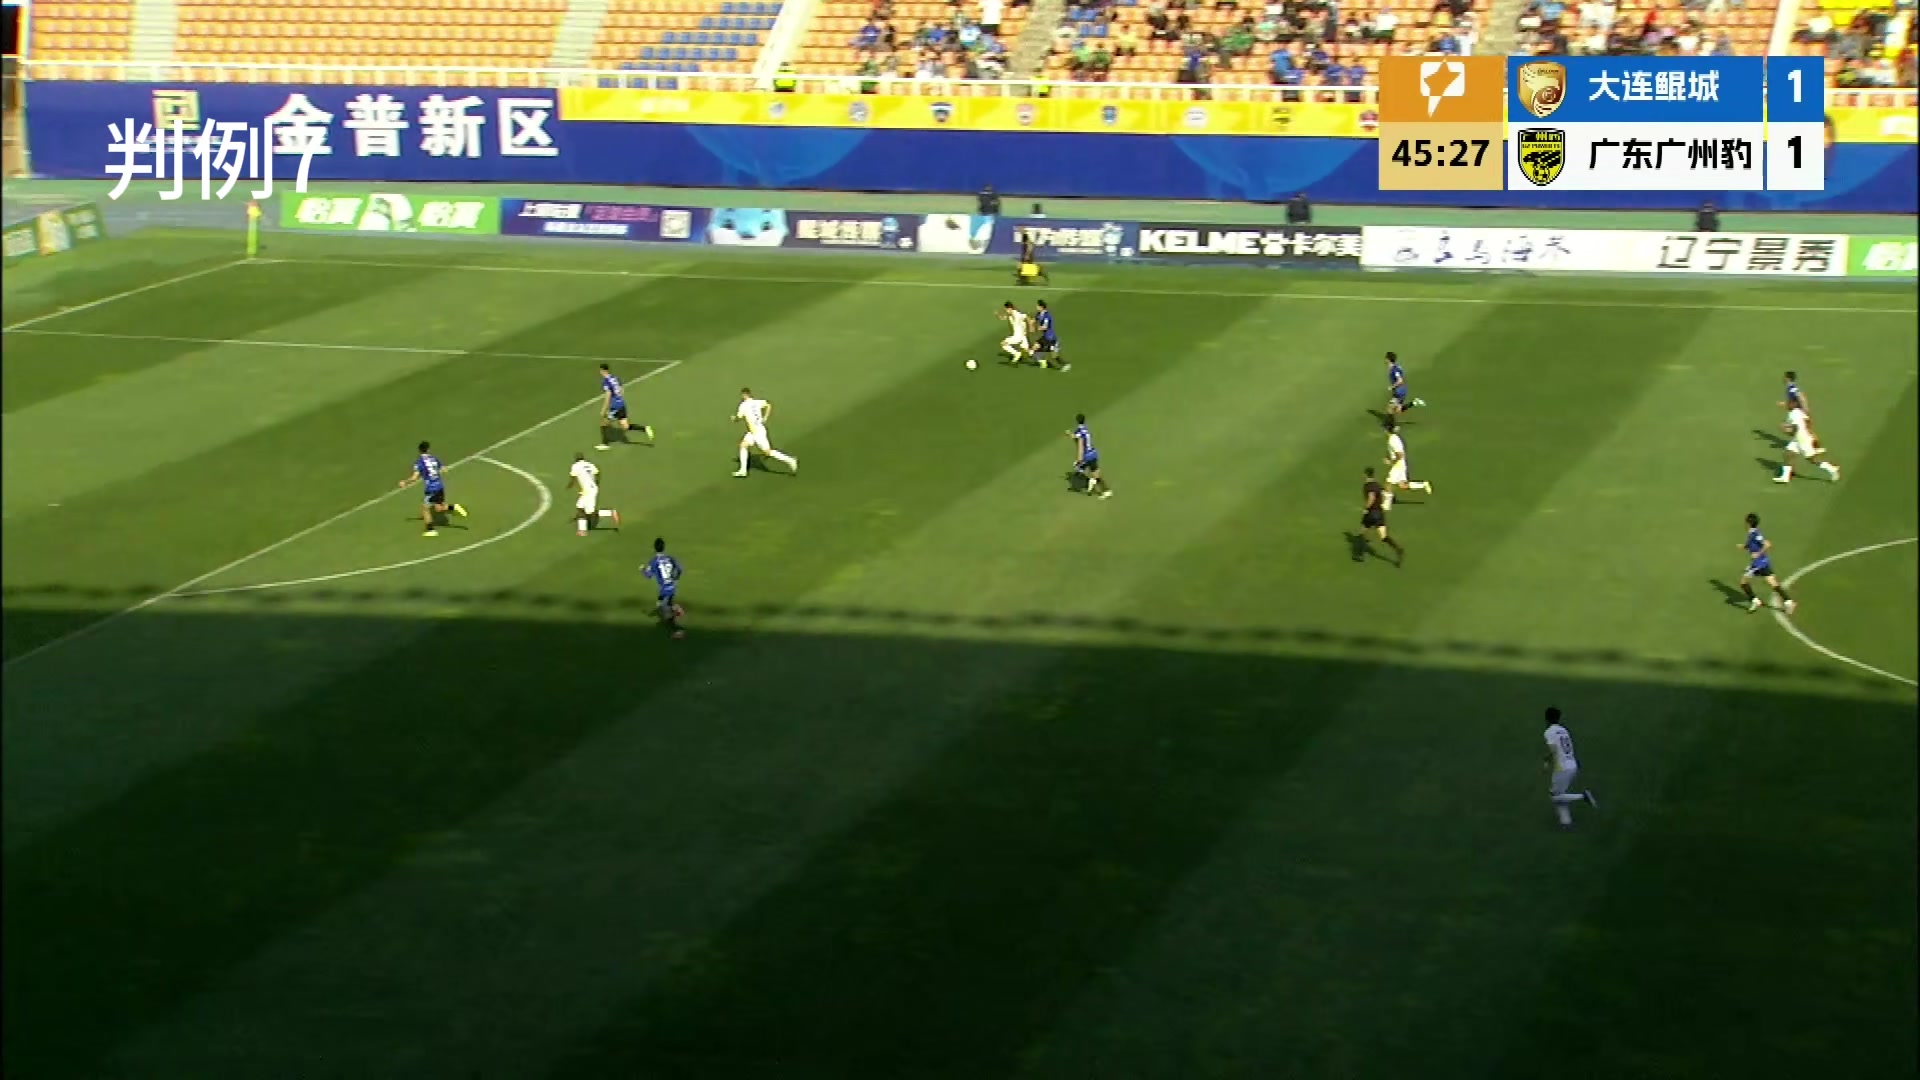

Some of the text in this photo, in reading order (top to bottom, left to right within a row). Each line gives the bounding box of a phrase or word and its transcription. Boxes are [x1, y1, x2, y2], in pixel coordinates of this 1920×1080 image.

[264, 93, 559, 157] 金普新区
[1139, 229, 1261, 254] KELME
[1656, 235, 1836, 272] 辽宁景秀
